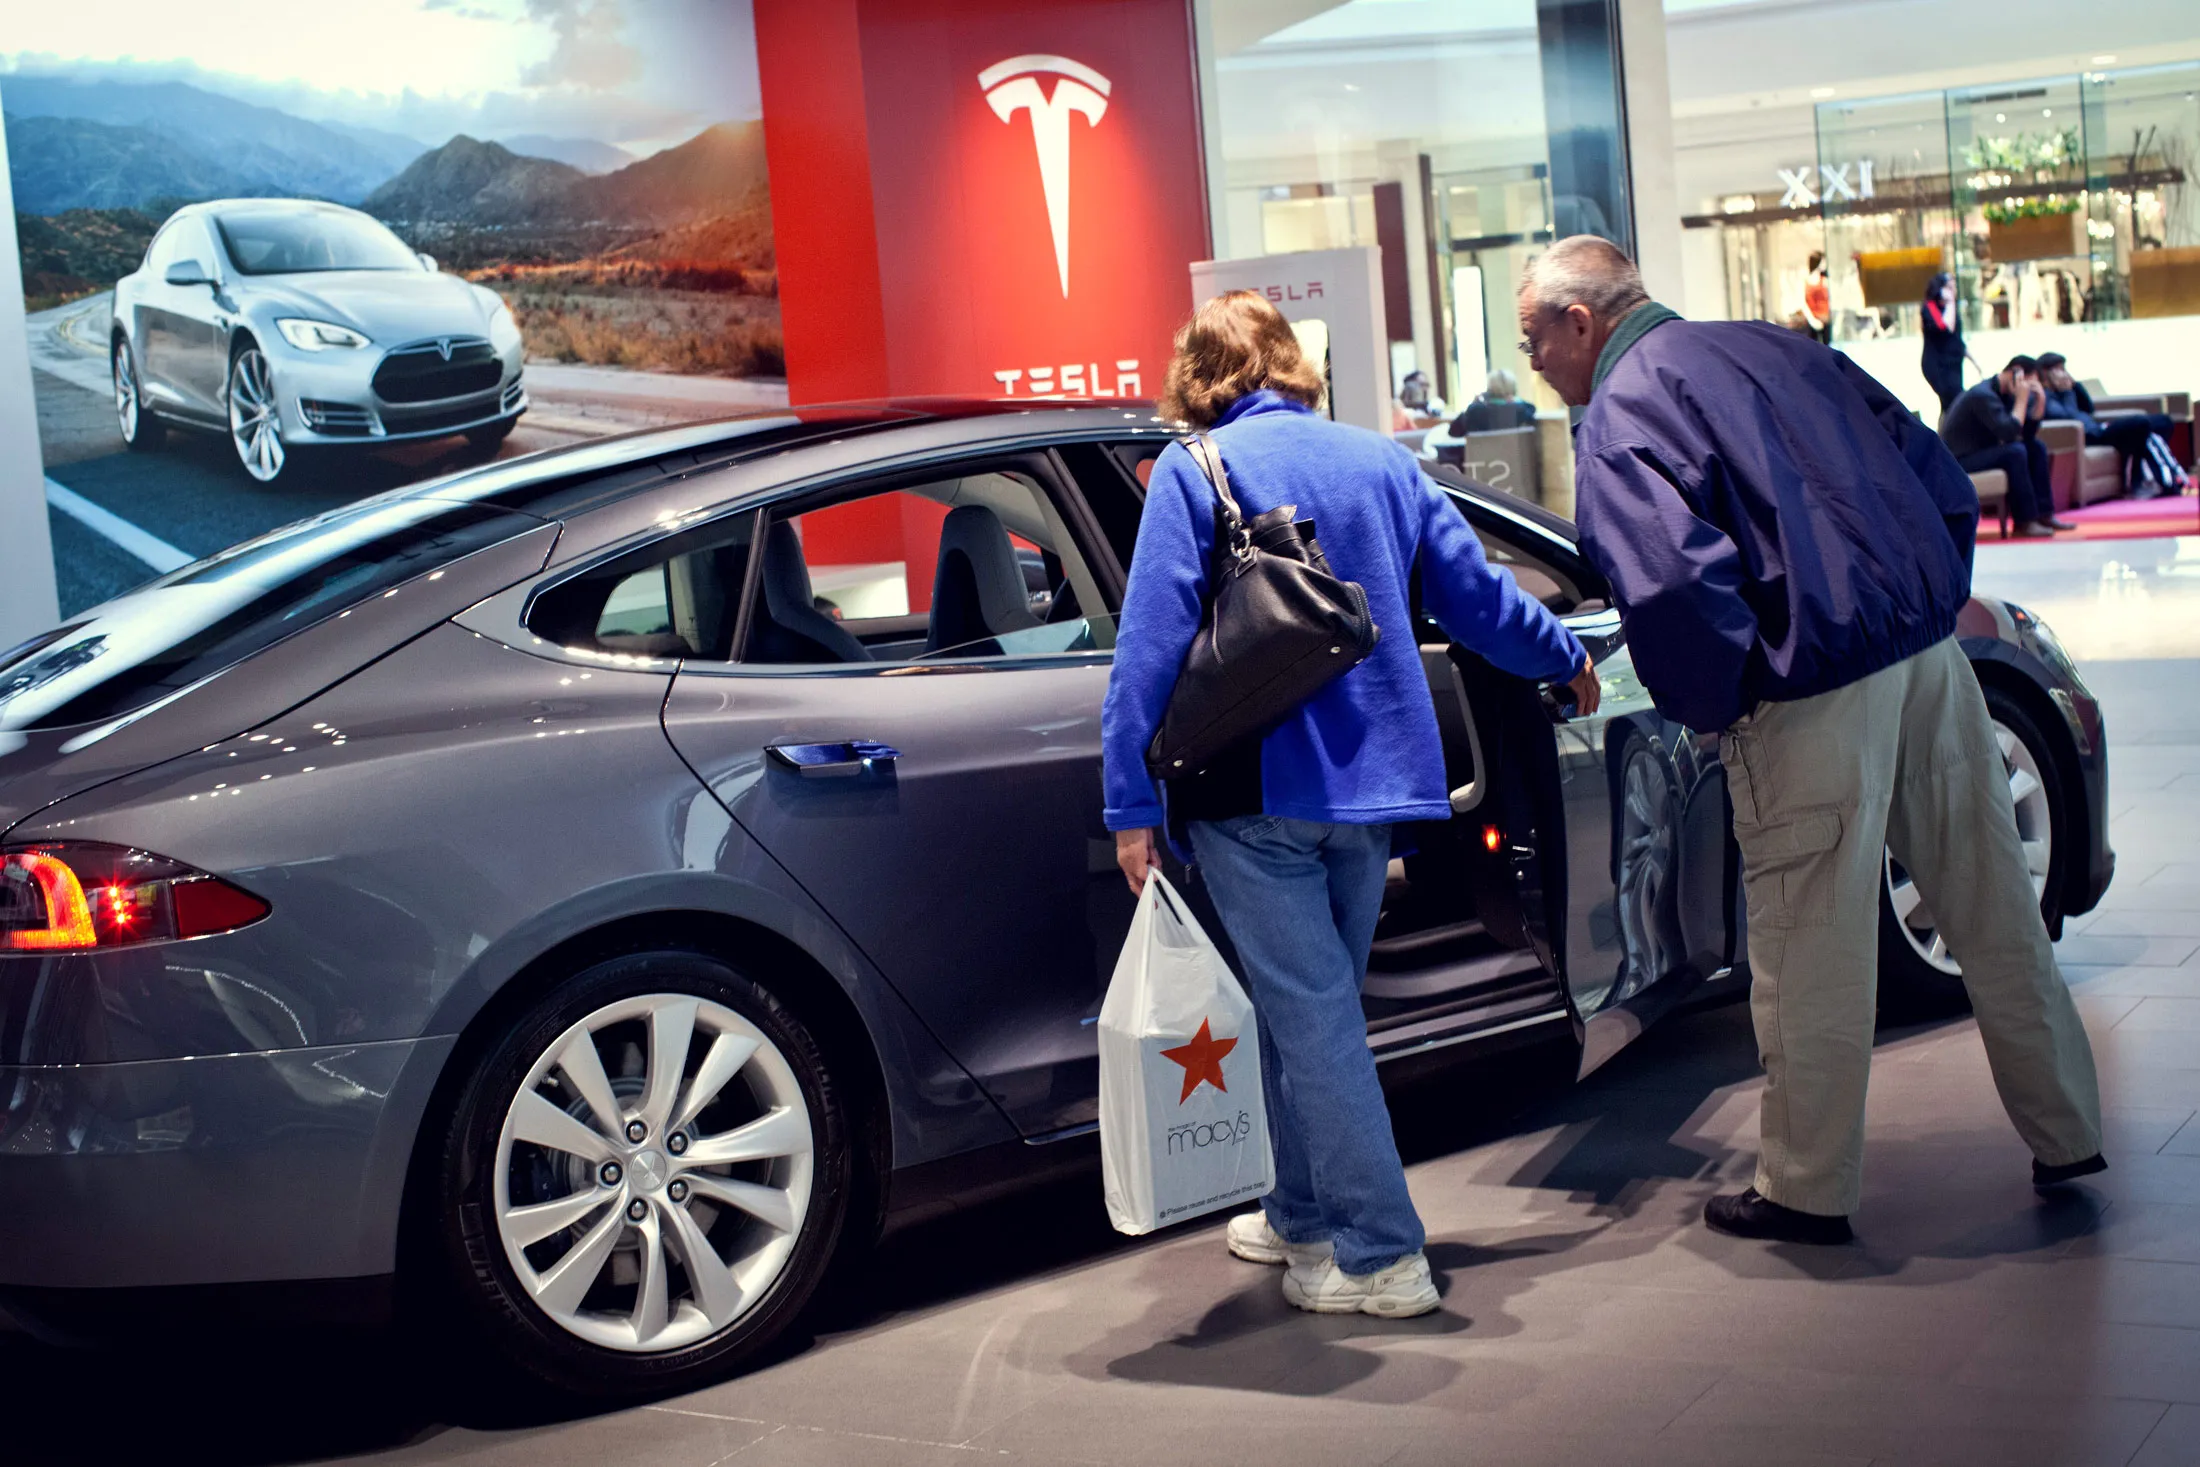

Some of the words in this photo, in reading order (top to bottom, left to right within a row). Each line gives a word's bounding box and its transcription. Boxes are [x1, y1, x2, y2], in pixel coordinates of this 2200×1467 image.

[1778, 160, 1875, 206] XXI
[1225, 281, 1324, 302] SLA
[993, 359, 1142, 398] TESLA
[1168, 1110, 1250, 1155] macy's
[1166, 1204, 1188, 1216] Please
[1206, 1195, 1219, 1204] and
